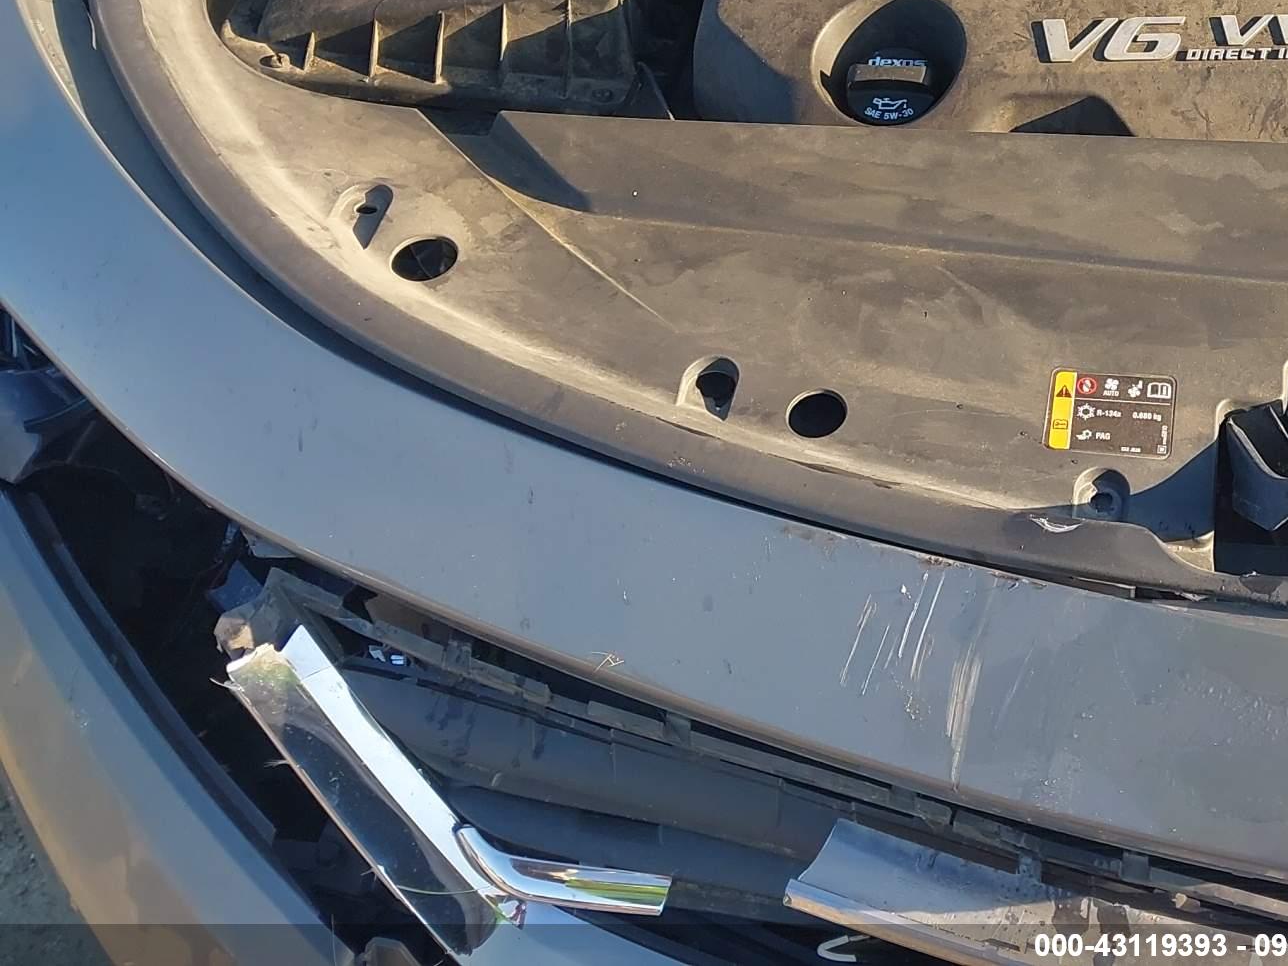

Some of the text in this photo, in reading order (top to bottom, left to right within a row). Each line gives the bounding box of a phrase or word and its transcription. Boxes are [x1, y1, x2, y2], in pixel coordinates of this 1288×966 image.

[1034, 15, 1186, 63] V6
[1185, 46, 1272, 61] DIRECT
[867, 56, 929, 67] dexos
[864, 106, 914, 120] SAE 5W-30
[1102, 389, 1120, 397] AUTO
[1095, 432, 1111, 441] PAG
